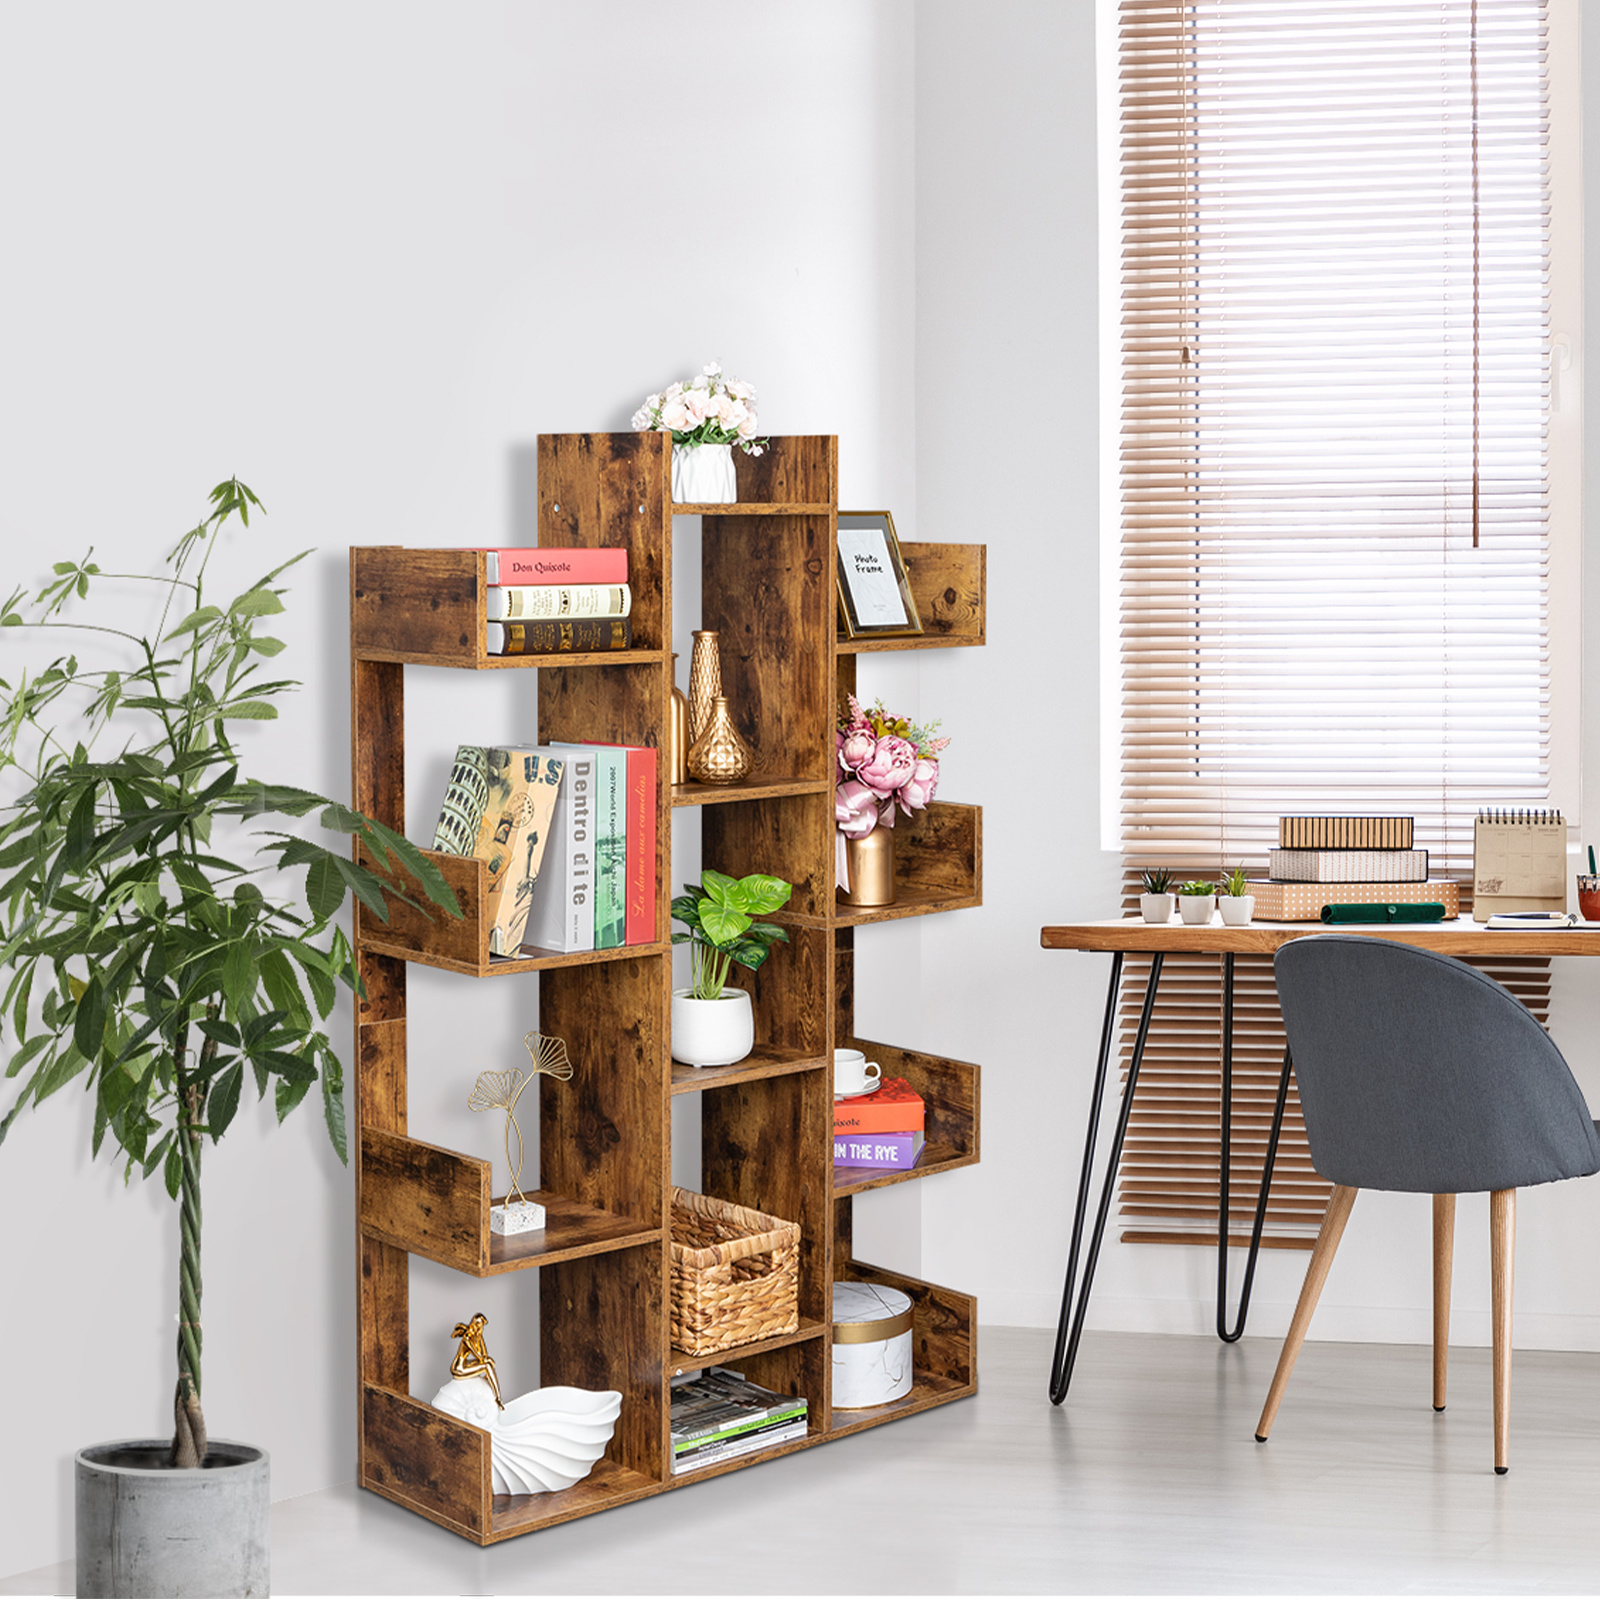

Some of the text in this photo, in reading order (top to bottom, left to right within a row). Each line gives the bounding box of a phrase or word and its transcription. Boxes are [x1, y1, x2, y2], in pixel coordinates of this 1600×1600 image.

[512, 562, 571, 575] Don Quixote
[854, 554, 878, 563] Photo
[855, 564, 883, 573] Frame
[574, 762, 591, 842] Dentro
[634, 857, 646, 893] dame
[573, 883, 588, 905] te
[632, 895, 645, 918] La
[834, 1143, 899, 1162] IN THE RYE
